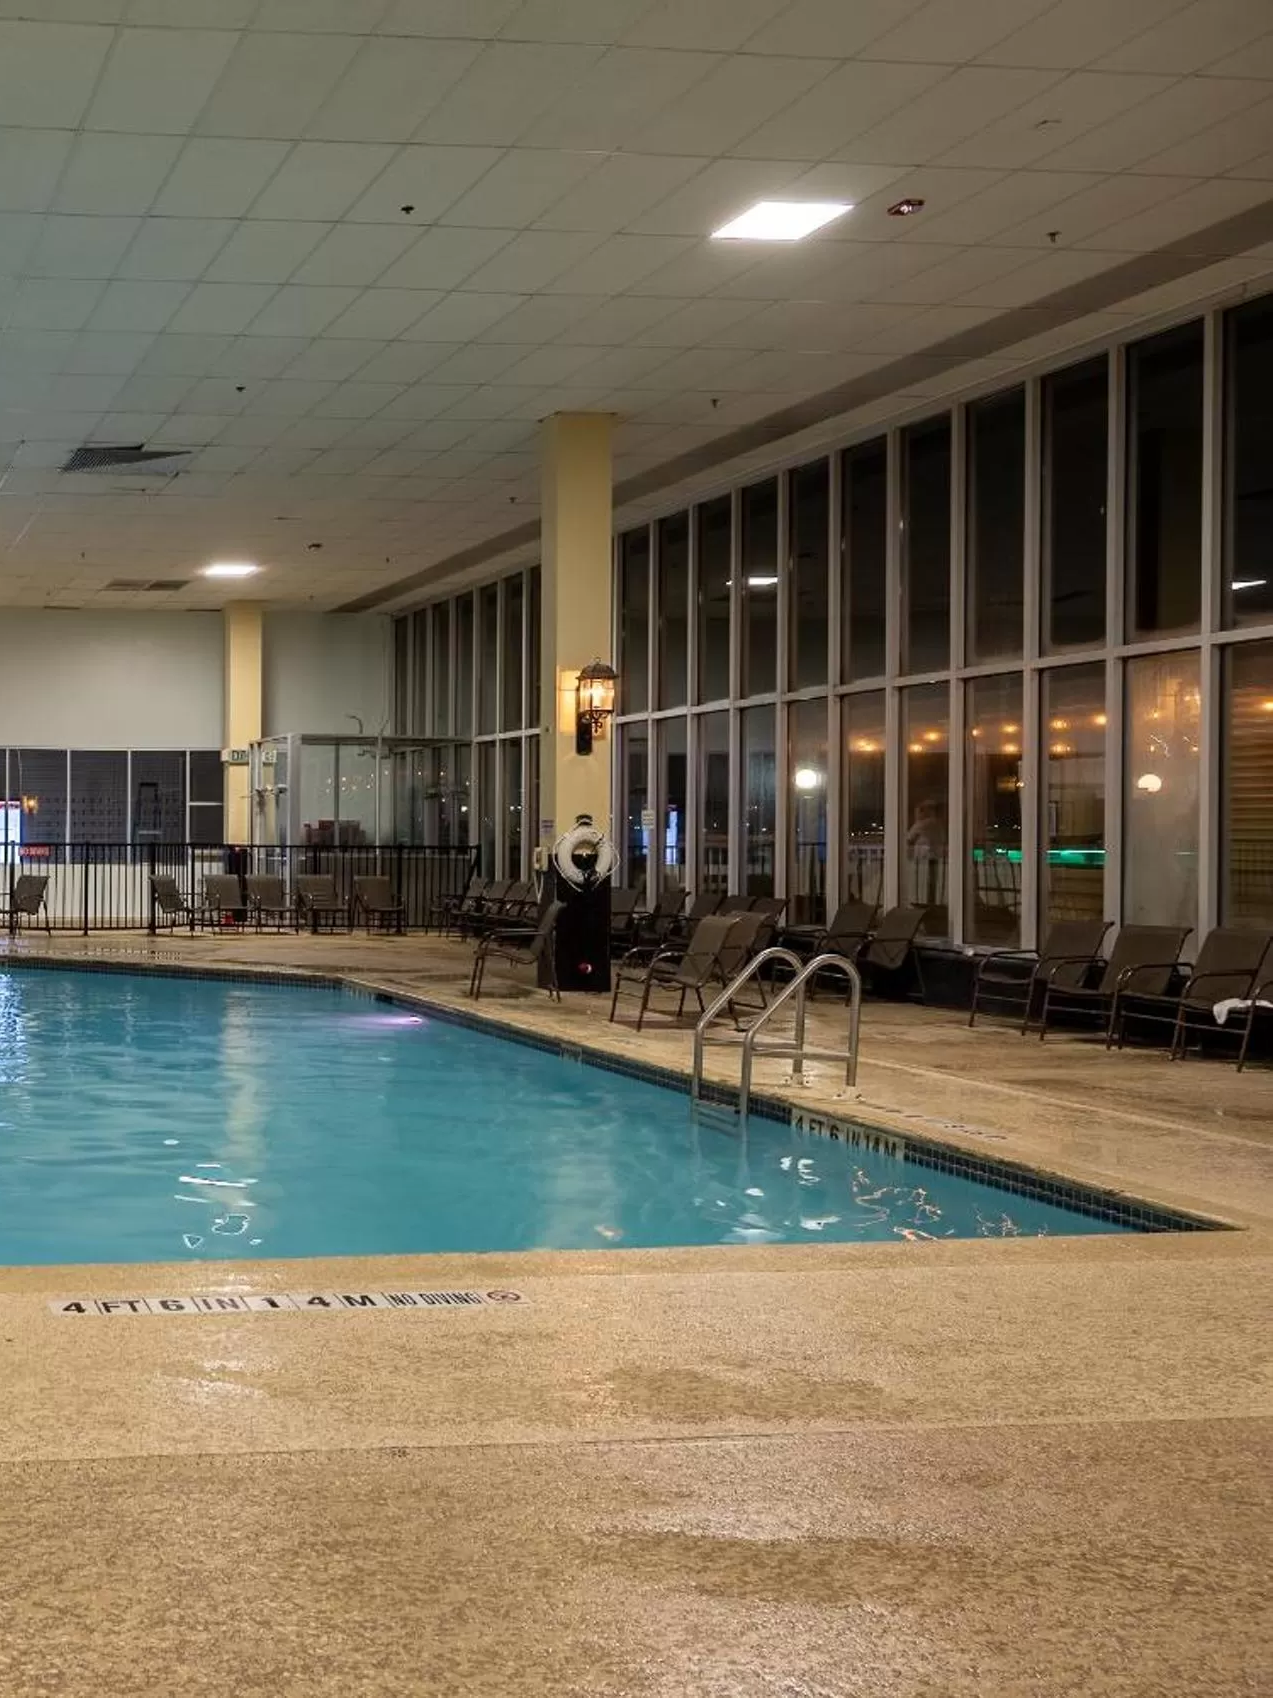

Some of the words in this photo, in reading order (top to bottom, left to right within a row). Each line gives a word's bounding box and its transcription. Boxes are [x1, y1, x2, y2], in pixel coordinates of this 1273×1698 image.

[62, 1301, 86, 1313] 4
[101, 1300, 140, 1313] FT
[158, 1299, 185, 1311] 6
[201, 1297, 240, 1310] IN
[307, 1295, 330, 1307] 4
[342, 1294, 377, 1307] M
[390, 1291, 417, 1306] NO
[419, 1291, 481, 1305] DIVING
